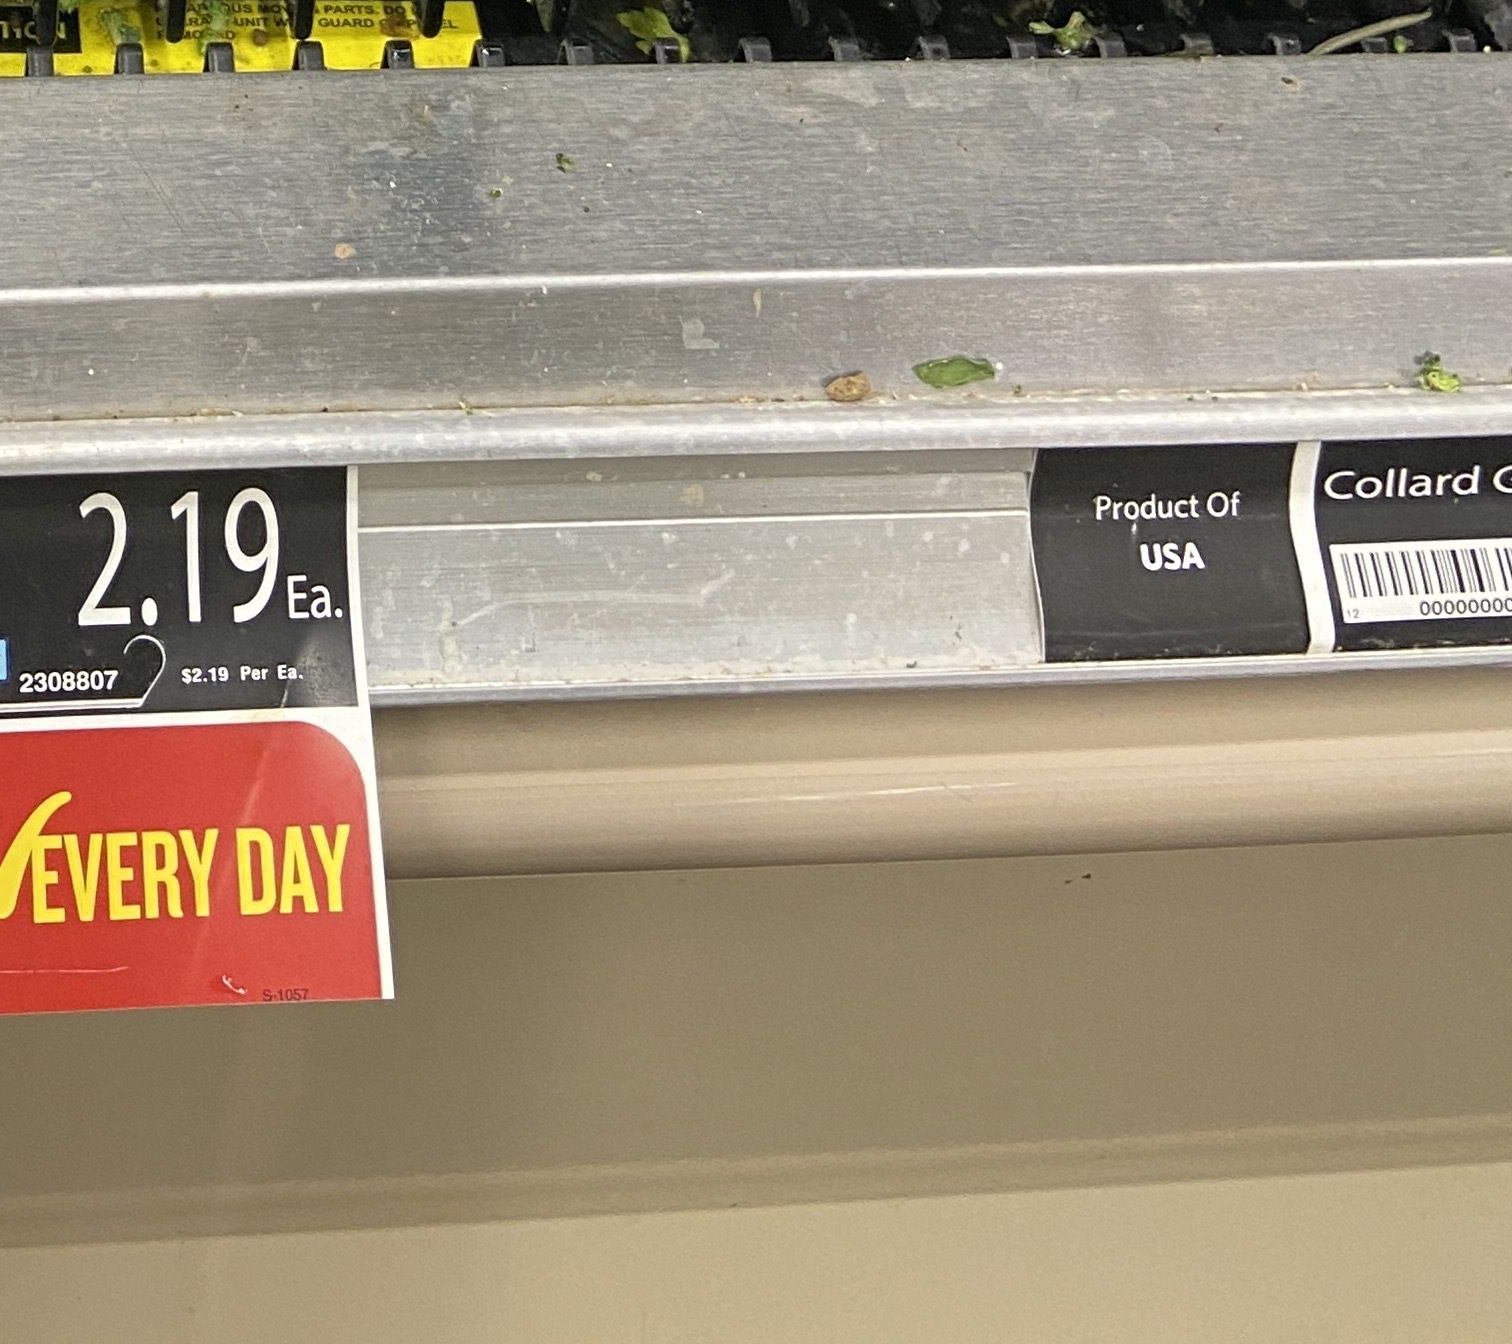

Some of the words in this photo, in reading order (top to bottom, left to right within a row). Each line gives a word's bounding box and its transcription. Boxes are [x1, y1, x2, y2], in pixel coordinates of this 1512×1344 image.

[318, 18, 375, 28] GUARD
[1324, 464, 1480, 500] Collard
[1095, 494, 1199, 521] Product
[1205, 490, 1241, 518] Of
[78, 487, 279, 627] 2.19
[287, 574, 343, 619] Ea.
[1139, 541, 1205, 572] USA
[18, 669, 119, 693] 2308807
[181, 666, 229, 685] $2.19
[240, 665, 269, 681] Per
[277, 664, 304, 680] Ea.
[33, 827, 221, 925] EVERY
[238, 823, 351, 916] DAY
